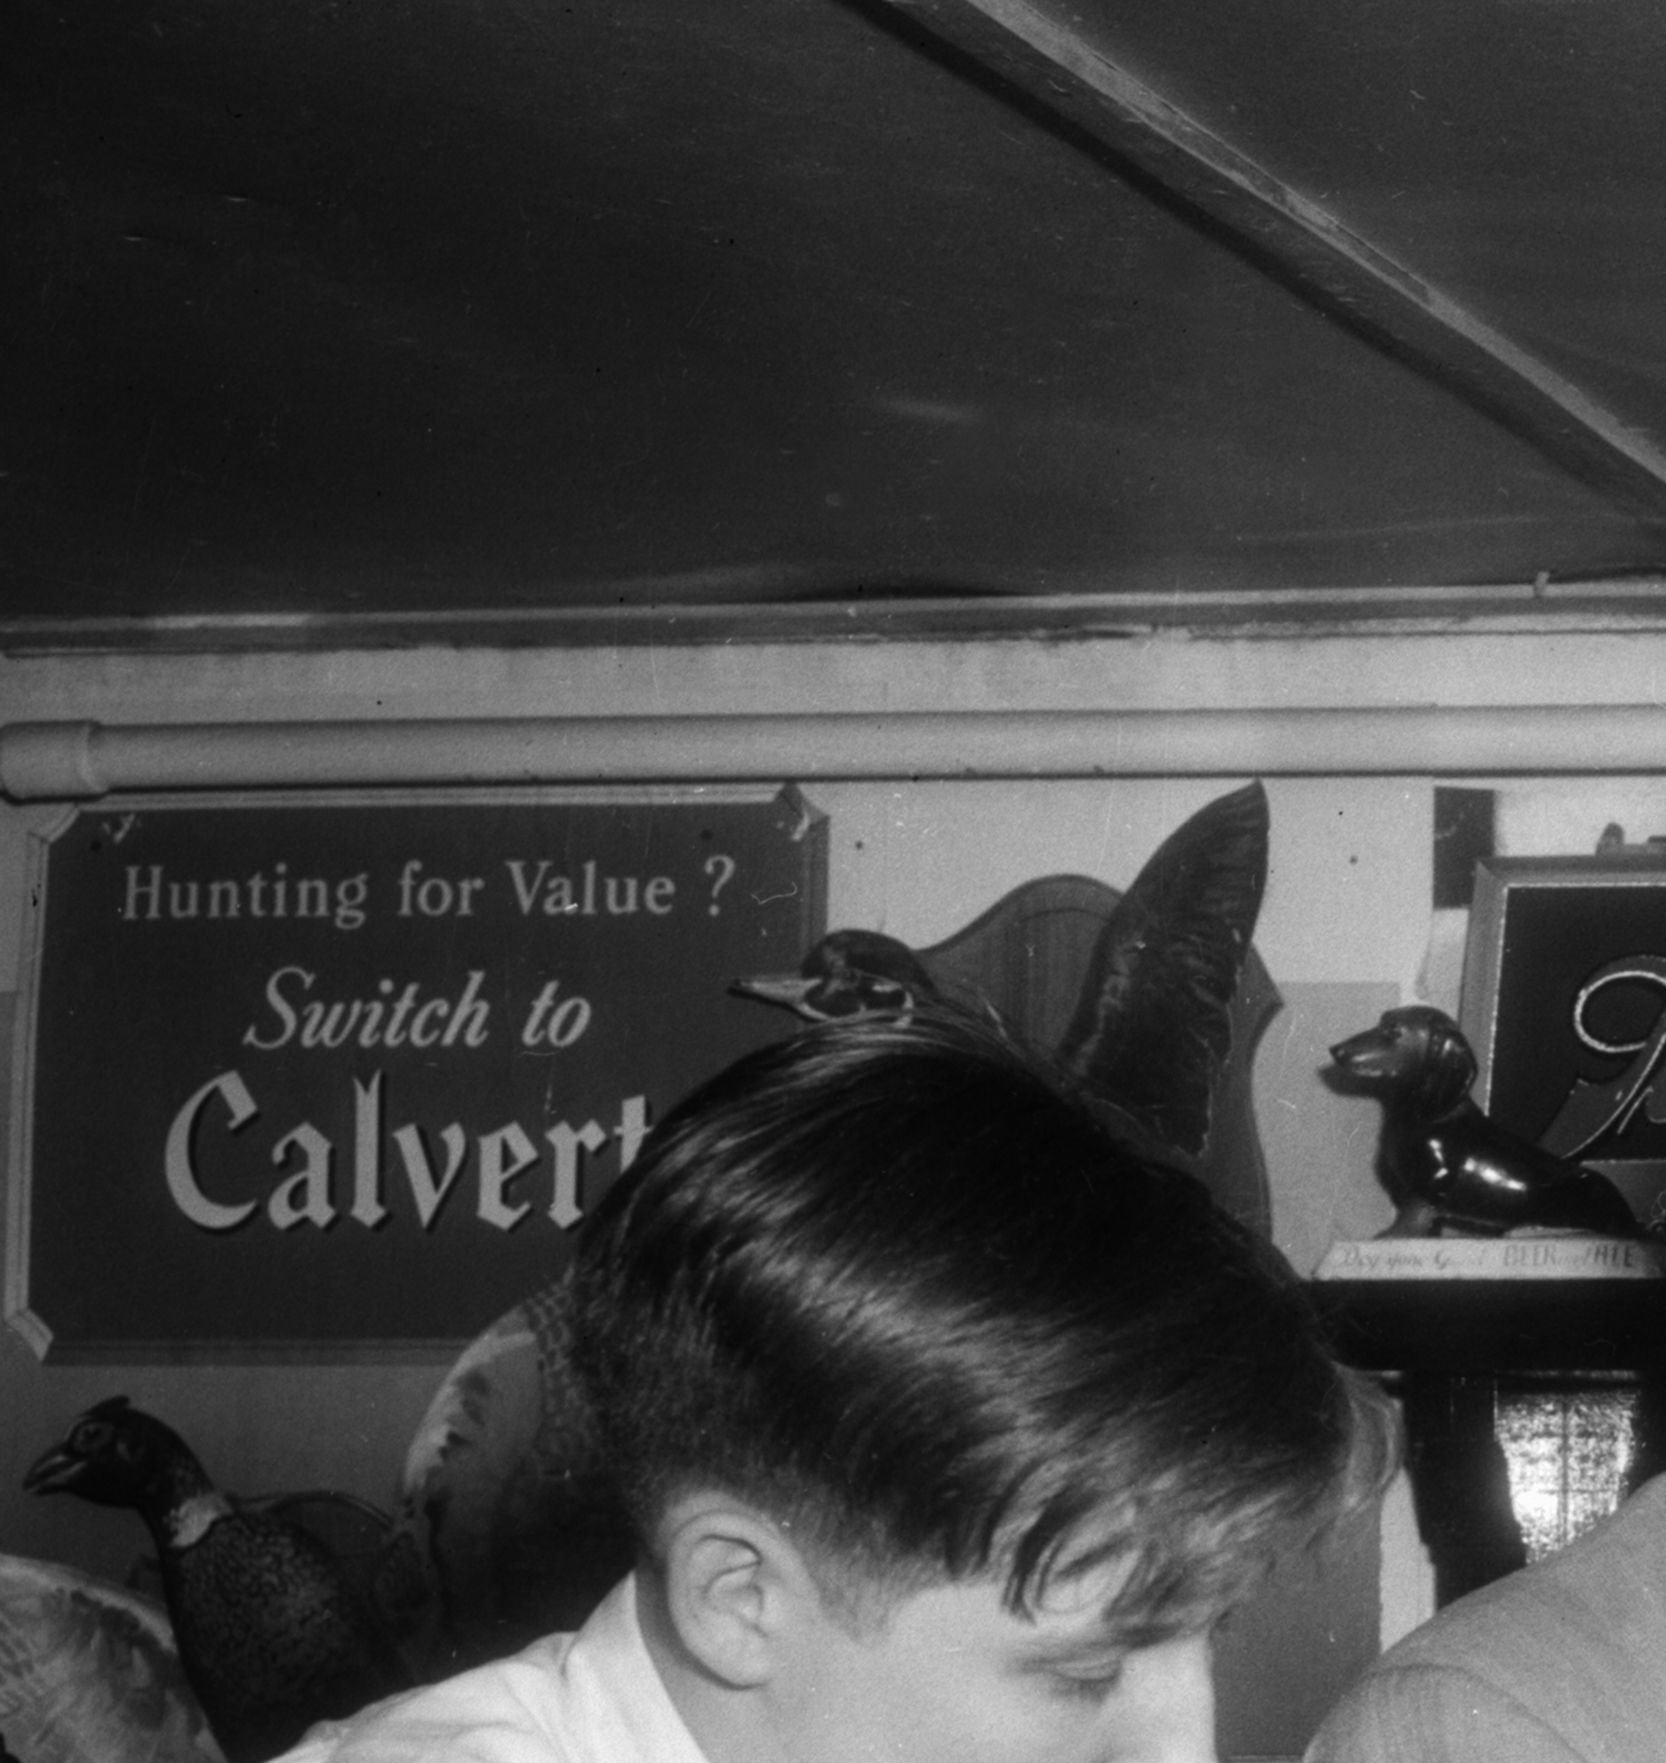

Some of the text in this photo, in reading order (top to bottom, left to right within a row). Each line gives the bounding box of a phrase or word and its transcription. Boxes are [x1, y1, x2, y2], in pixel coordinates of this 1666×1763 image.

[123, 862, 369, 930] Hunting
[398, 859, 484, 918] for
[505, 860, 678, 918] Value
[241, 965, 593, 1052] Switch to
